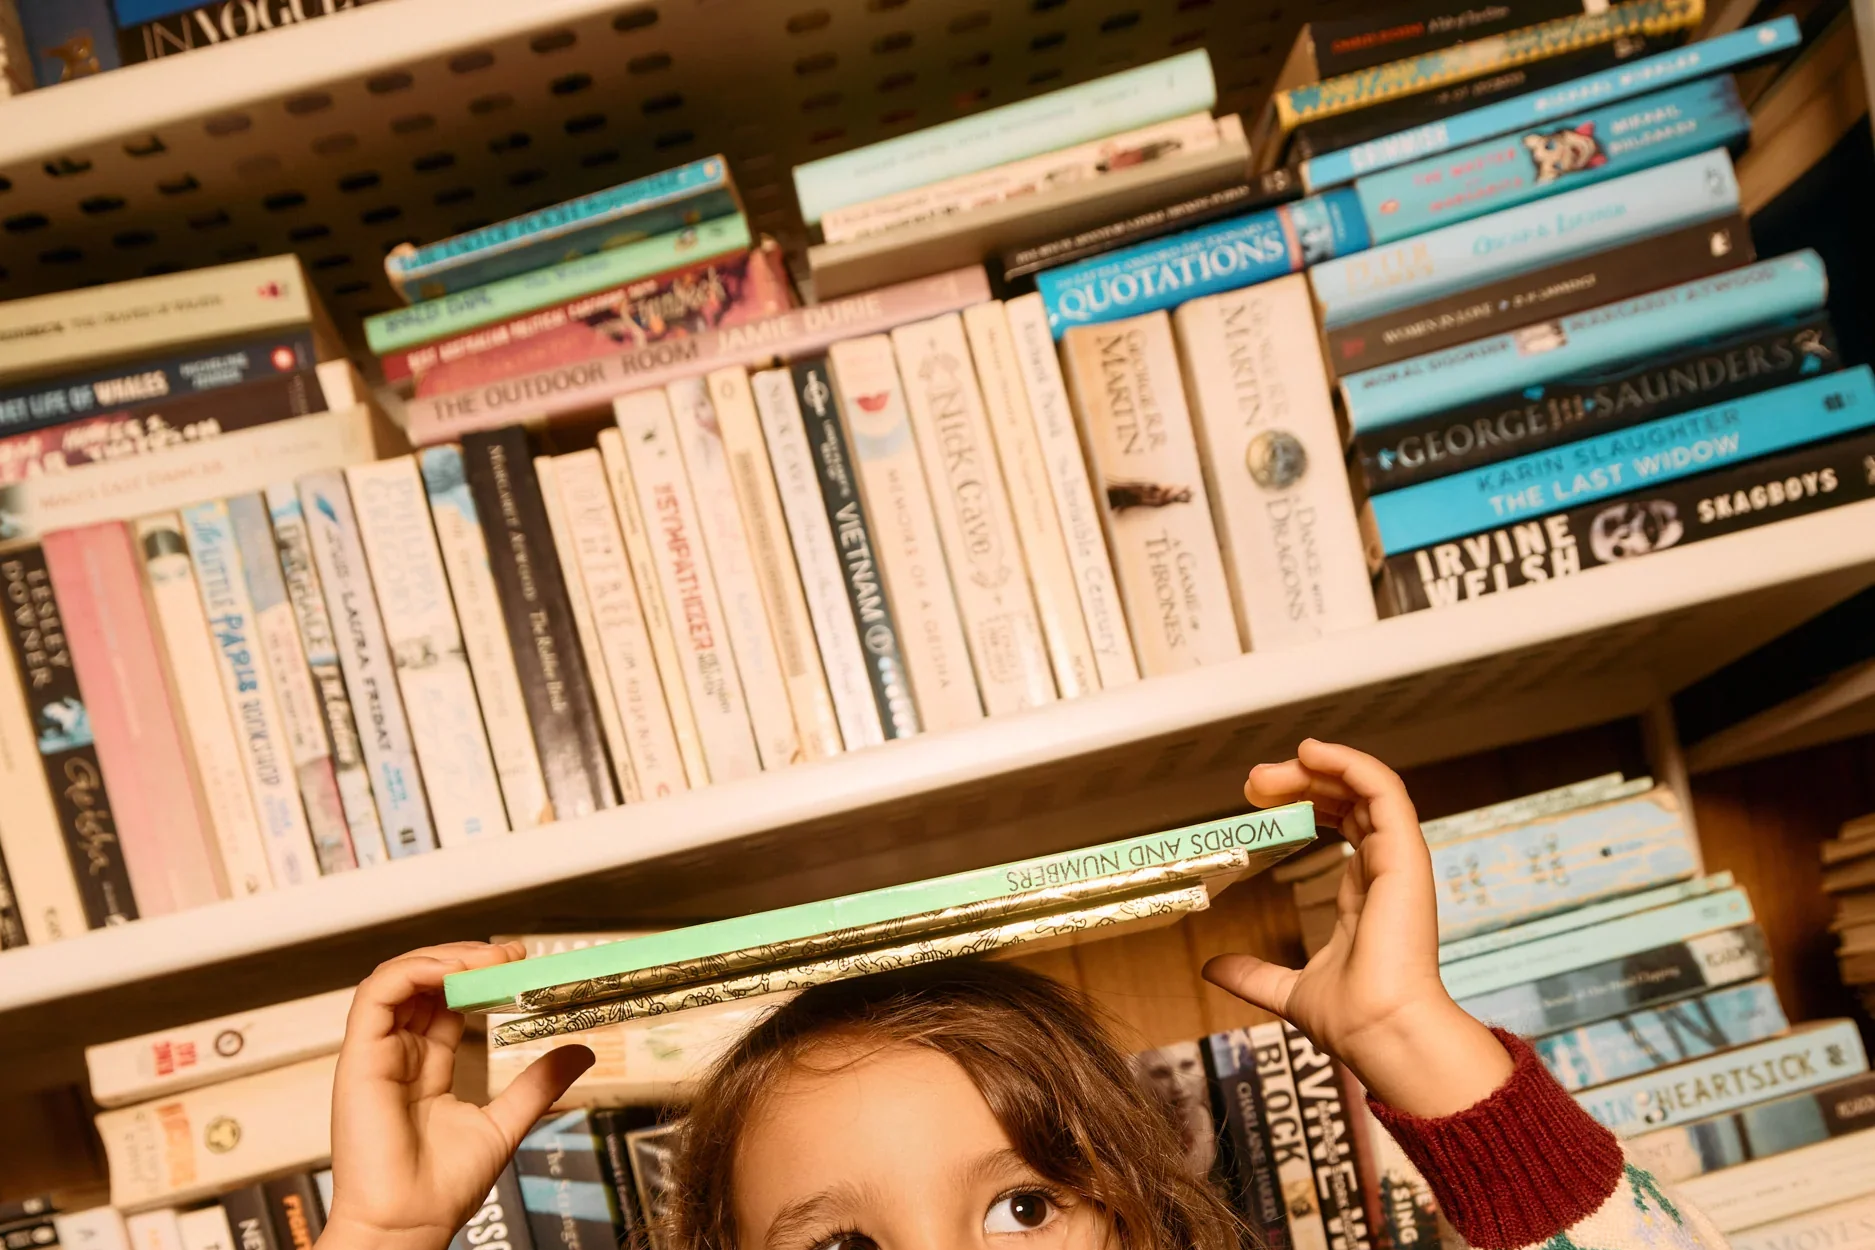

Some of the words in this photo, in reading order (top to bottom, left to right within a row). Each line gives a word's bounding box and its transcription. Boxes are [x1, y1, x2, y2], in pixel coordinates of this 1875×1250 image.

[143, 14, 194, 60] IN
[1531, 76, 1614, 113] MICHAEL
[1616, 49, 1701, 87] WINKLER
[1347, 124, 1451, 172] GRIMMISH
[1447, 146, 1518, 179] MASTER
[1052, 228, 1291, 326] QUOTATIONS
[1568, 290, 1681, 333] MARGARET
[1682, 263, 1778, 303] ATWOOD
[432, 391, 477, 424] THE
[482, 360, 606, 410] OUTDOOR
[619, 336, 699, 375] ROOM
[718, 320, 798, 352] JAMIE
[801, 292, 884, 335] DURIE
[437, 325, 512, 363] AUSTRALIAN
[1121, 326, 1163, 410] GEORGE
[1213, 300, 1274, 430] MARTIN
[1359, 361, 1424, 392] MORAL
[1588, 336, 1797, 418] SAUNDERS
[28, 387, 70, 420] LIFE
[67, 382, 96, 414] OF
[92, 368, 171, 407] WHALES
[1091, 331, 1150, 458] MARTIN
[1393, 404, 1549, 471] GEORGE
[1475, 453, 1565, 494] KARIN
[1571, 405, 1744, 468] SLAUGHTER
[484, 442, 524, 528] MARGARET
[1488, 484, 1546, 518] THE
[1551, 463, 1622, 502] LAST
[1633, 431, 1745, 478] WIDOW
[1694, 466, 1841, 527] SKAGBOYS
[357, 474, 420, 619] GREGORY
[384, 474, 447, 614] PHILIPPA
[881, 465, 920, 558] MEMOIRS
[1060, 476, 1098, 558] Invisible
[1290, 504, 1330, 577] DANCE
[195, 544, 237, 611] LITTLE
[505, 528, 544, 604] ATWOOD
[653, 495, 716, 653] SYMPATHIZER
[830, 501, 886, 623] VIETNAM
[908, 563, 928, 591] OF
[1172, 549, 1206, 613] GAME
[1262, 495, 1316, 623] DRAGONS
[1413, 512, 1577, 585] IRVINE
[1422, 545, 1584, 612] WELSH
[0, 557, 54, 691] DOWNER
[24, 567, 71, 672] LESLEY
[526, 607, 549, 634] The
[916, 596, 934, 613] A
[1078, 564, 1124, 660] Century
[1139, 529, 1195, 650] THRONES
[209, 610, 262, 698] PARIS
[337, 588, 375, 669] LAURA
[359, 674, 398, 753] FRIDAY
[532, 633, 561, 681] Robber
[921, 618, 955, 691] GEISHA
[543, 678, 569, 715] Bride
[1005, 850, 1121, 893] NUMBERS
[1127, 837, 1183, 867] AND
[1189, 816, 1284, 854] WORDS
[1246, 1041, 1308, 1167] BLOCK
[1651, 1047, 1818, 1116] HEARTSICK
[541, 1138, 567, 1176] The
[1232, 1080, 1270, 1166] CHARLAINE
[1386, 1185, 1421, 1245] SING
